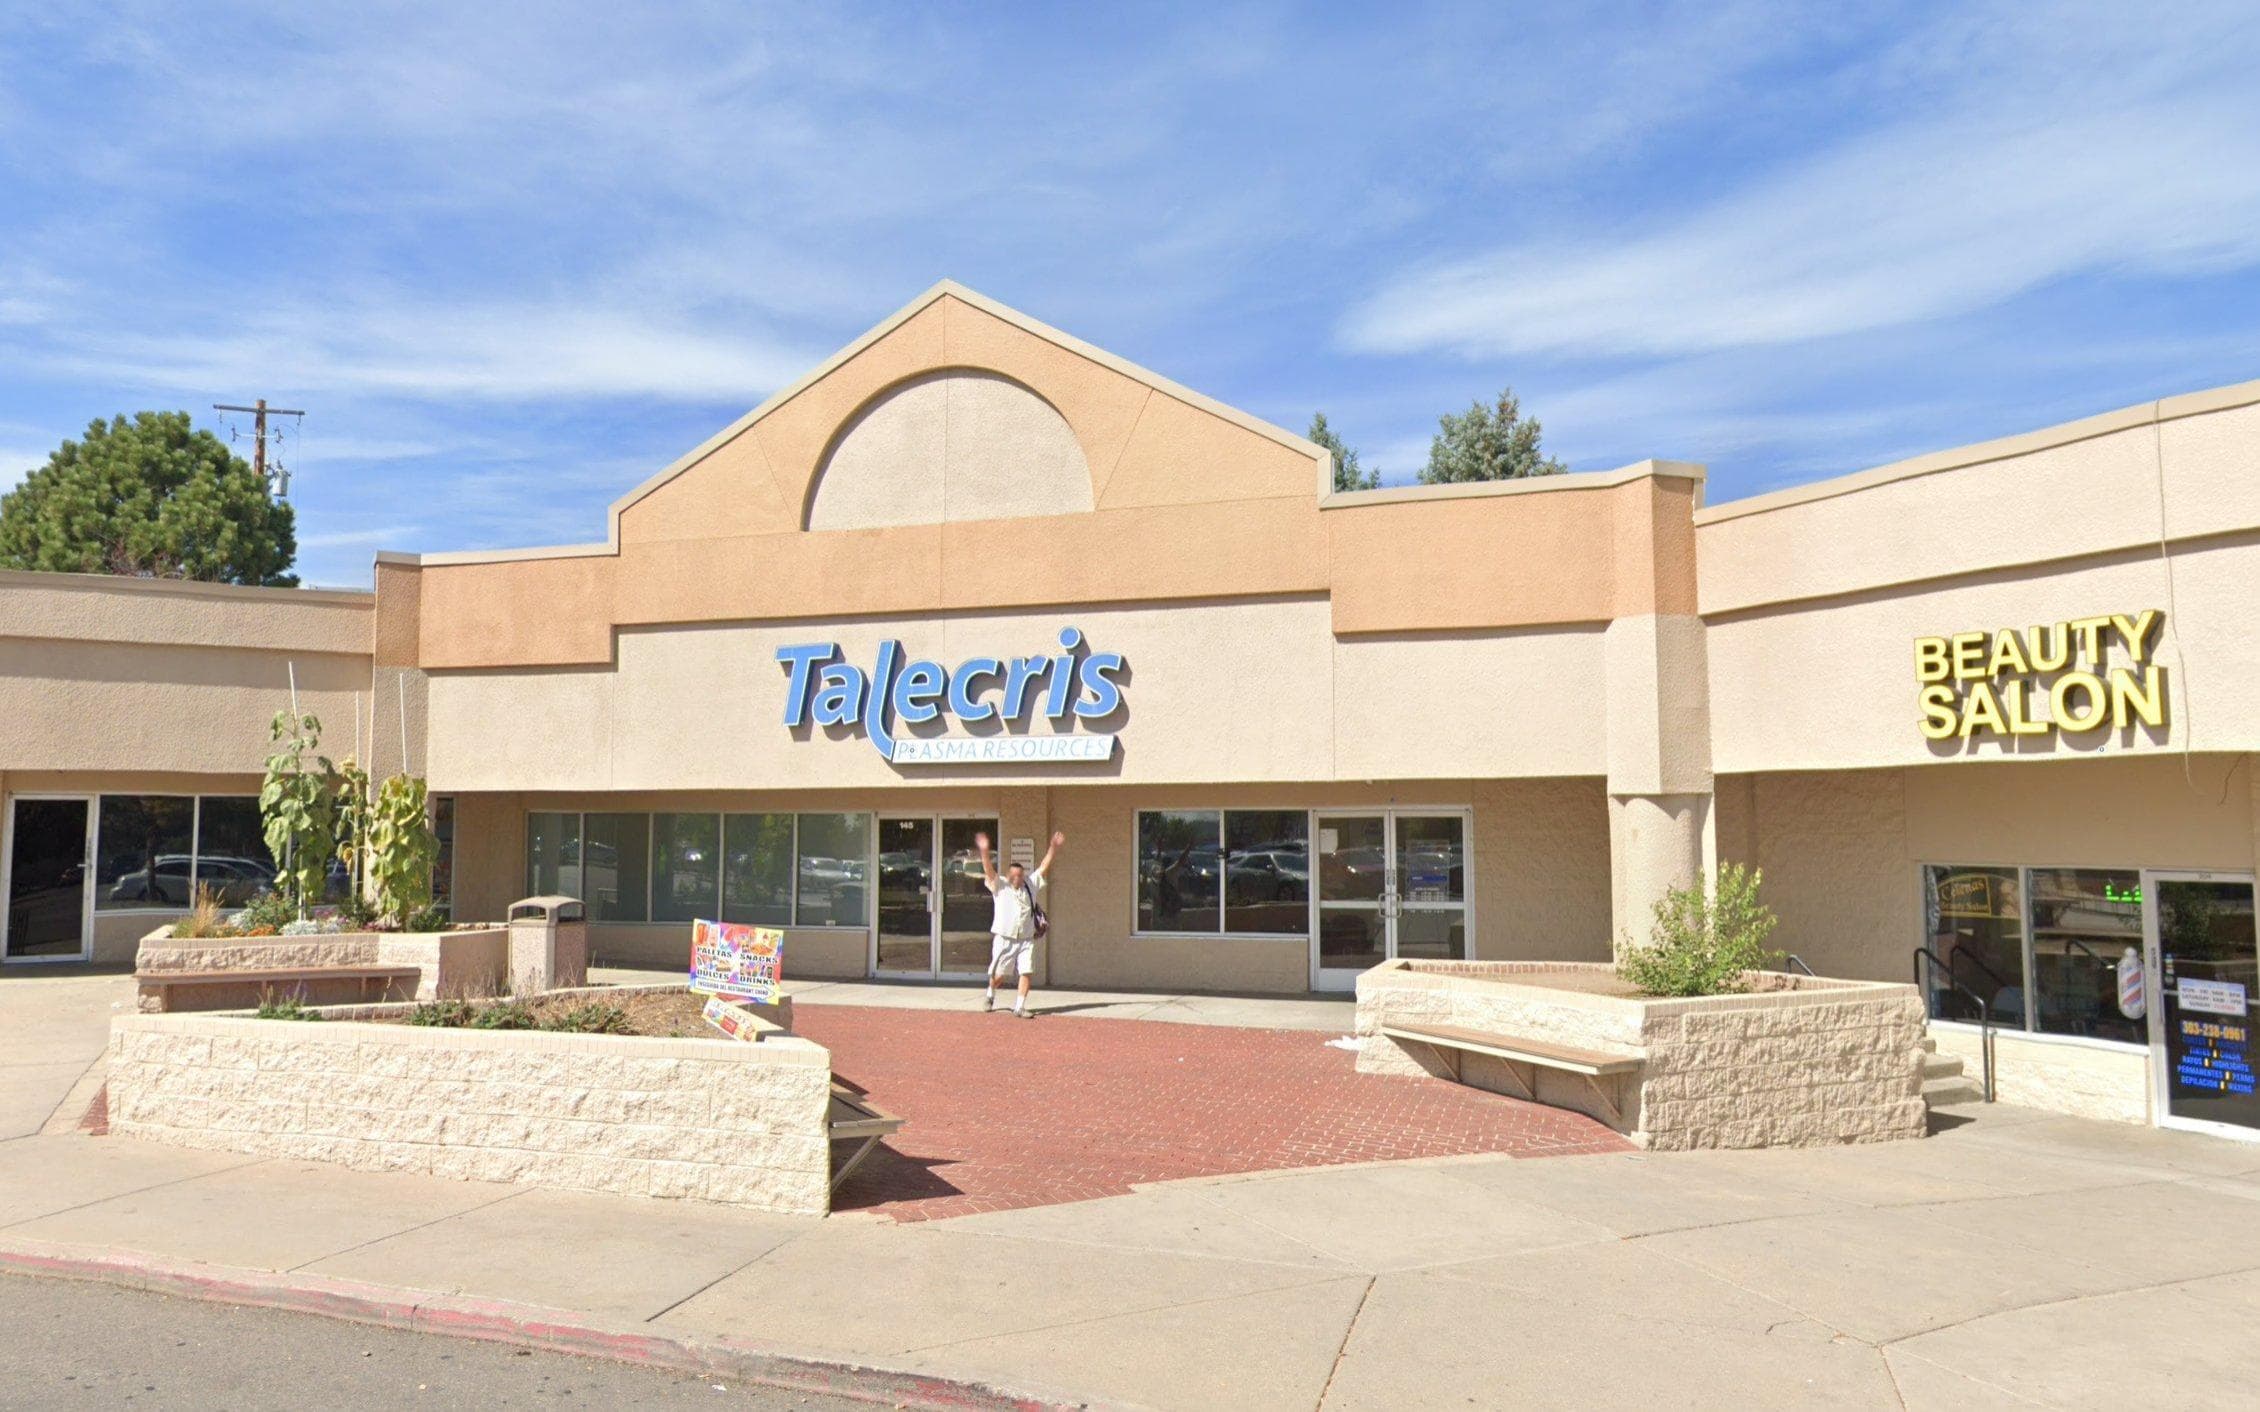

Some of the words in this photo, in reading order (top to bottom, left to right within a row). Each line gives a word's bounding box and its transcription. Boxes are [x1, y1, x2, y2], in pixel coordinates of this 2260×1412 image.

[1913, 609, 2158, 682] BEAUTY
[774, 625, 1122, 761] Talecris
[1917, 665, 2166, 740] SALON
[898, 740, 977, 760] PLASMA
[982, 738, 1107, 759] RESOURCES
[740, 953, 778, 964] SNACKS
[697, 969, 730, 980] DULCES
[740, 975, 776, 986] DRINKS
